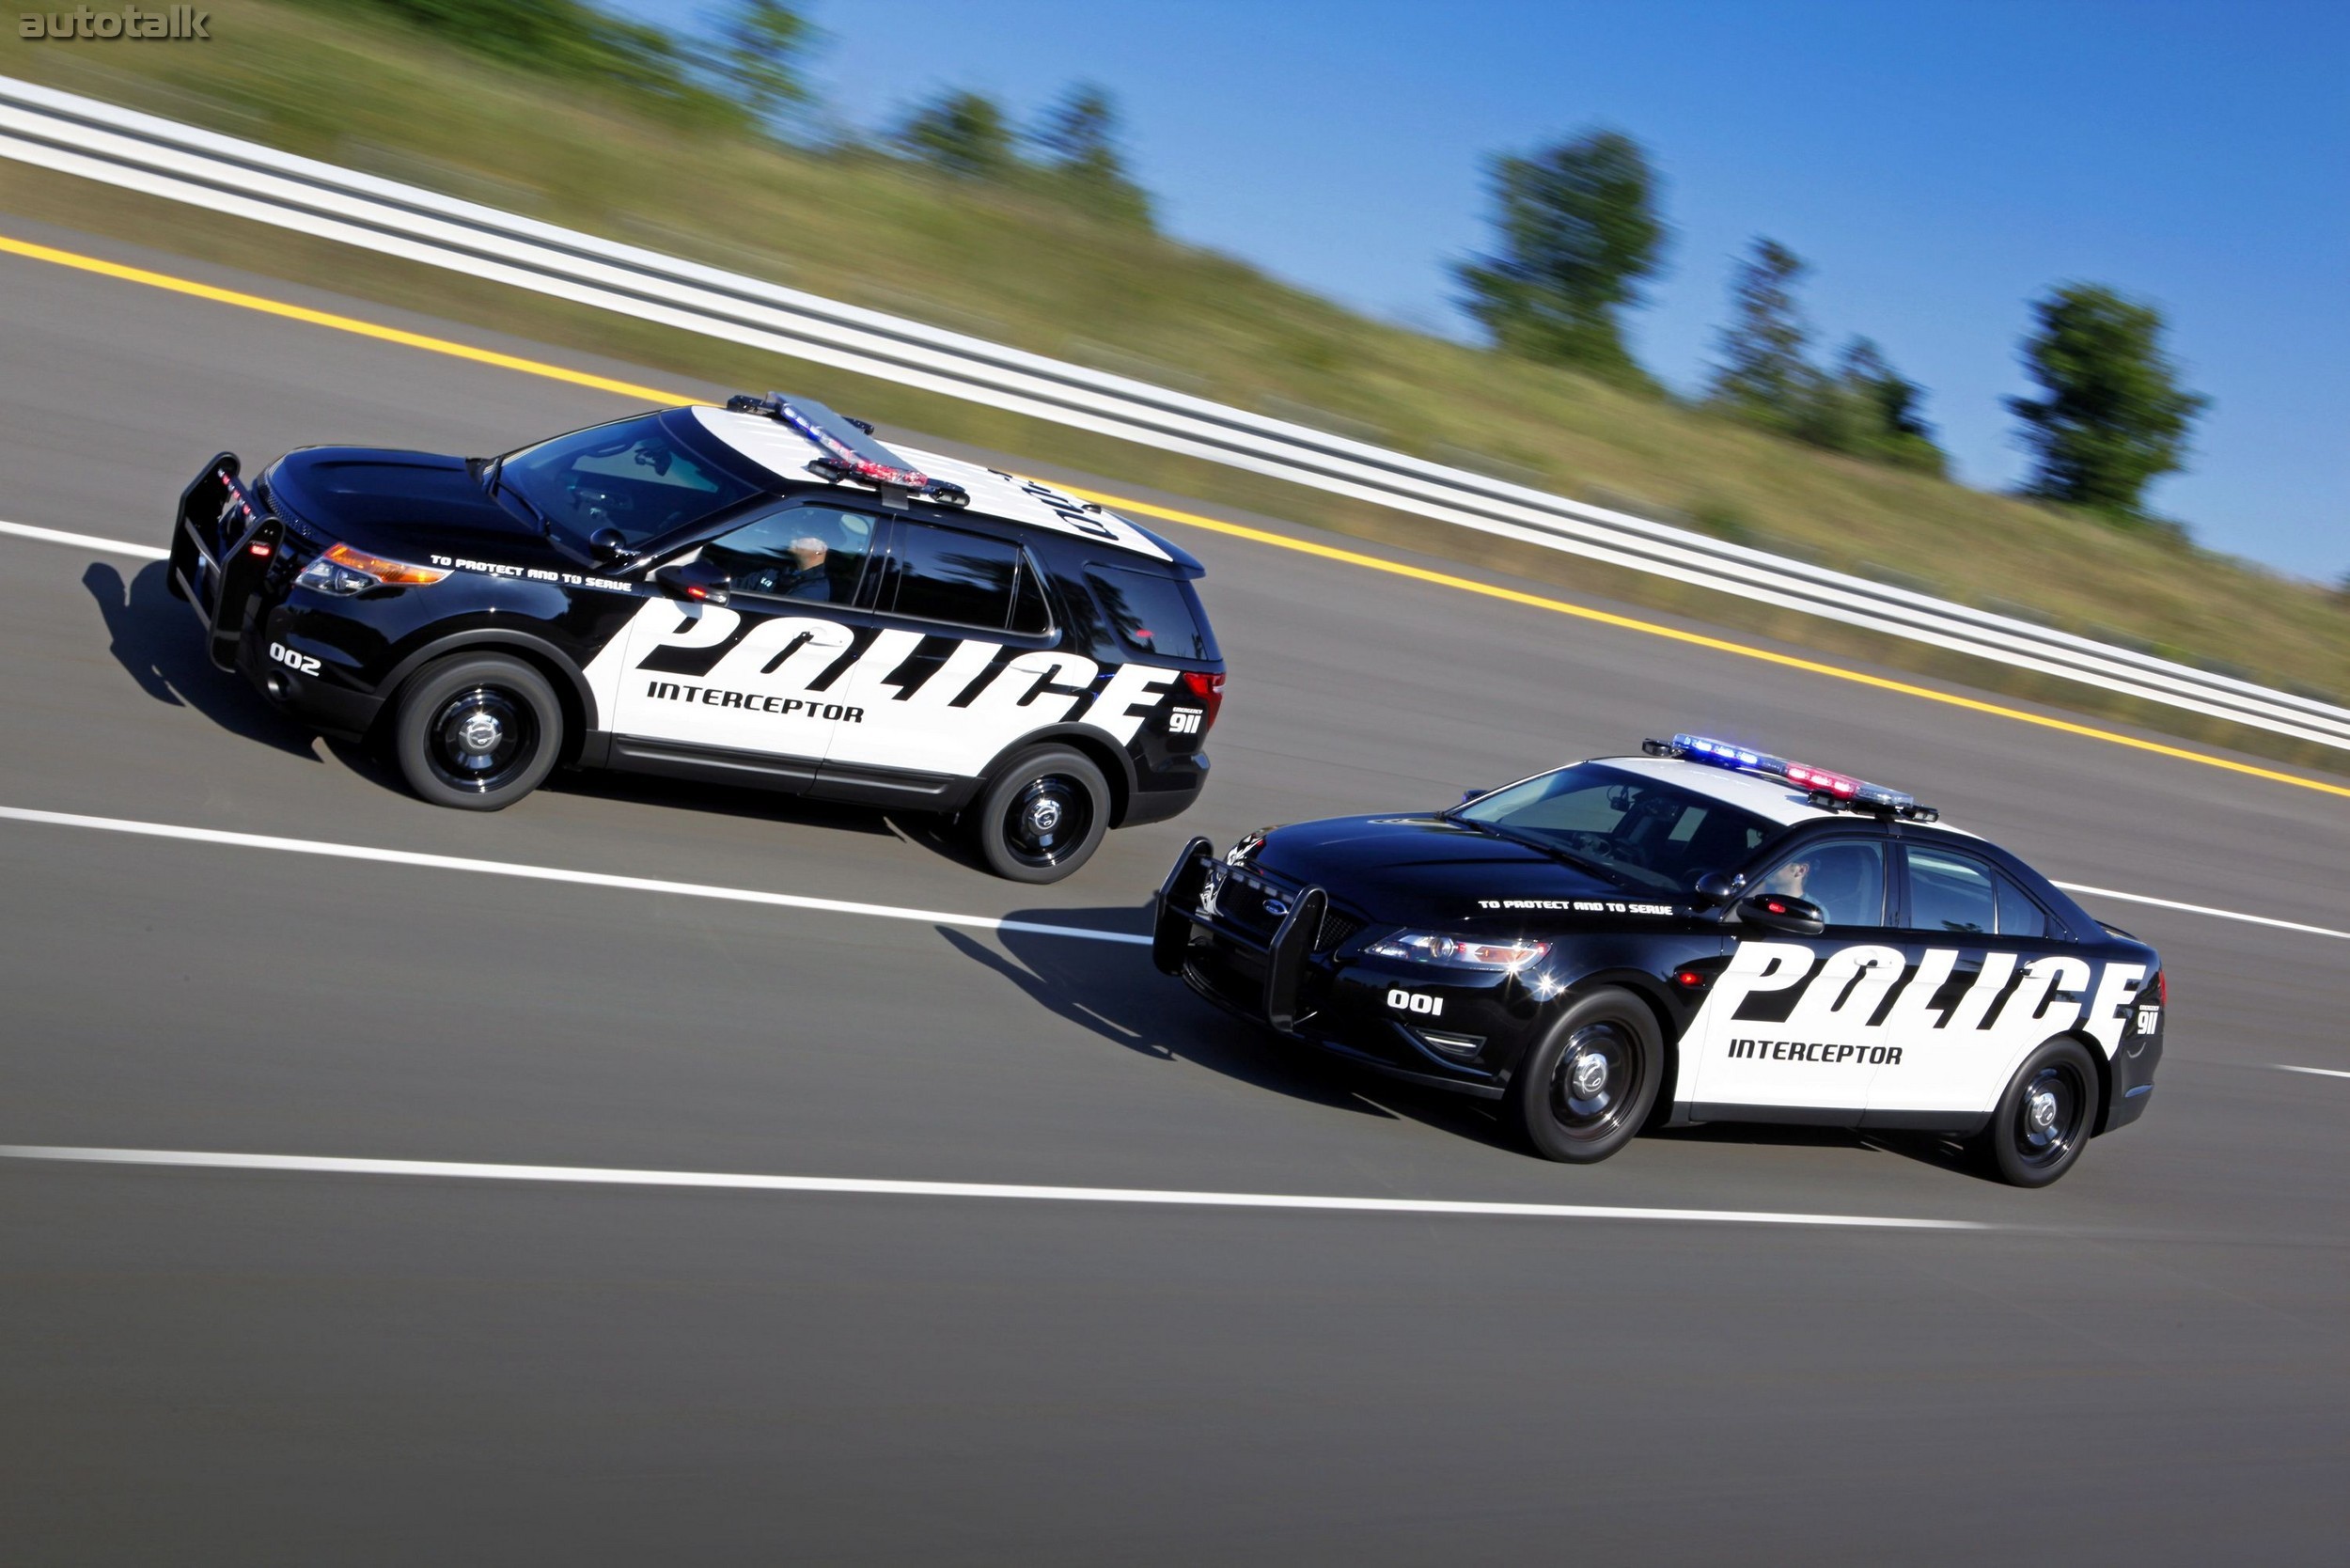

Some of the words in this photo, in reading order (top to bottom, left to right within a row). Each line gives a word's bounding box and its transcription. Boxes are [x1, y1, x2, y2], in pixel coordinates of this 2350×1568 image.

[431, 555, 452, 566] TO
[455, 558, 525, 576] PROTECT
[527, 569, 558, 581] AND
[561, 573, 582, 585] TO
[585, 577, 633, 592] SERVE
[269, 642, 321, 677] 002
[590, 596, 1181, 747] POLICE
[647, 682, 865, 724] INTERCEPTOR
[1168, 713, 1201, 733] 911
[1478, 901, 1500, 909] TO
[1503, 901, 1570, 910] PROTECT
[1573, 902, 1604, 912] AND
[1606, 902, 1626, 913] TO
[1628, 903, 1674, 916] SERVE
[1387, 989, 1444, 1016] 001
[1692, 941, 2147, 1060] POLICE
[2138, 1011, 2158, 1035] 911
[1728, 1039, 1903, 1065] INTERCEPTOR
